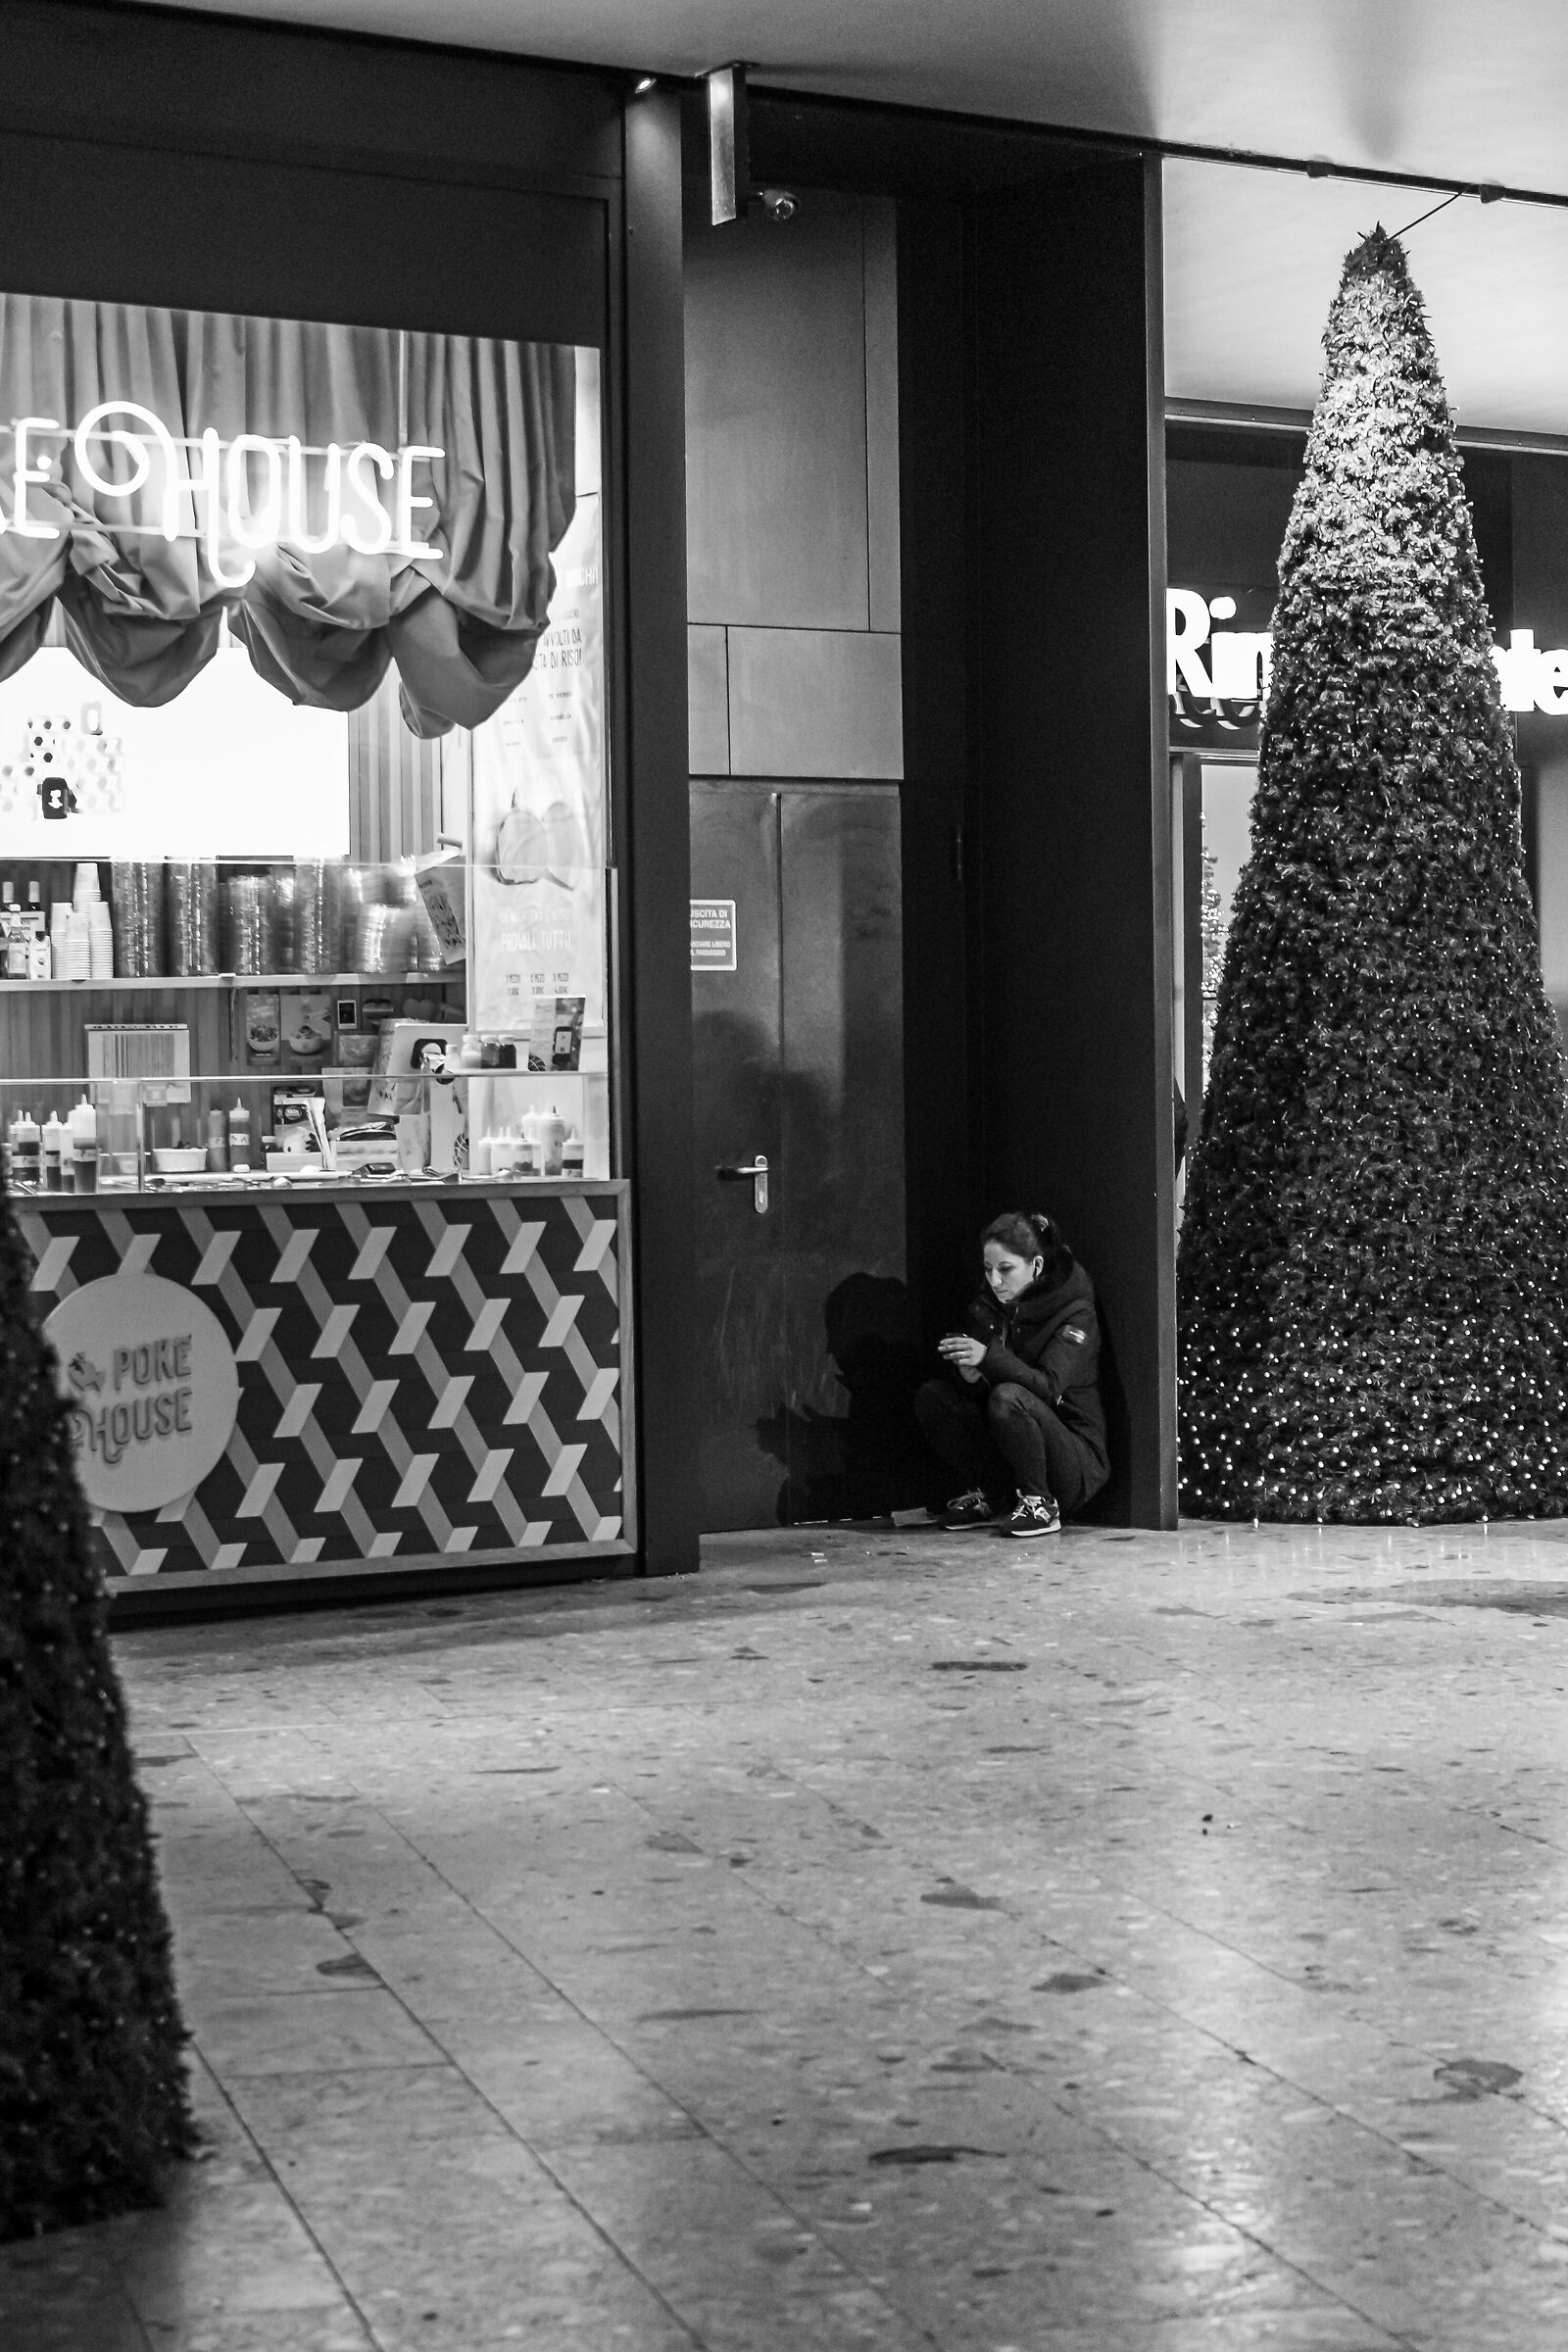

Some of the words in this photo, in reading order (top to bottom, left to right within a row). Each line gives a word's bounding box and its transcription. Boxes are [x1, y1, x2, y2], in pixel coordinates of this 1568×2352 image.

[74, 400, 447, 588] HOUSE
[690, 919, 731, 928] ICUREZZA
[718, 908, 728, 918] DI
[113, 1334, 193, 1392] POKE
[67, 1387, 193, 1464] HOUSE
